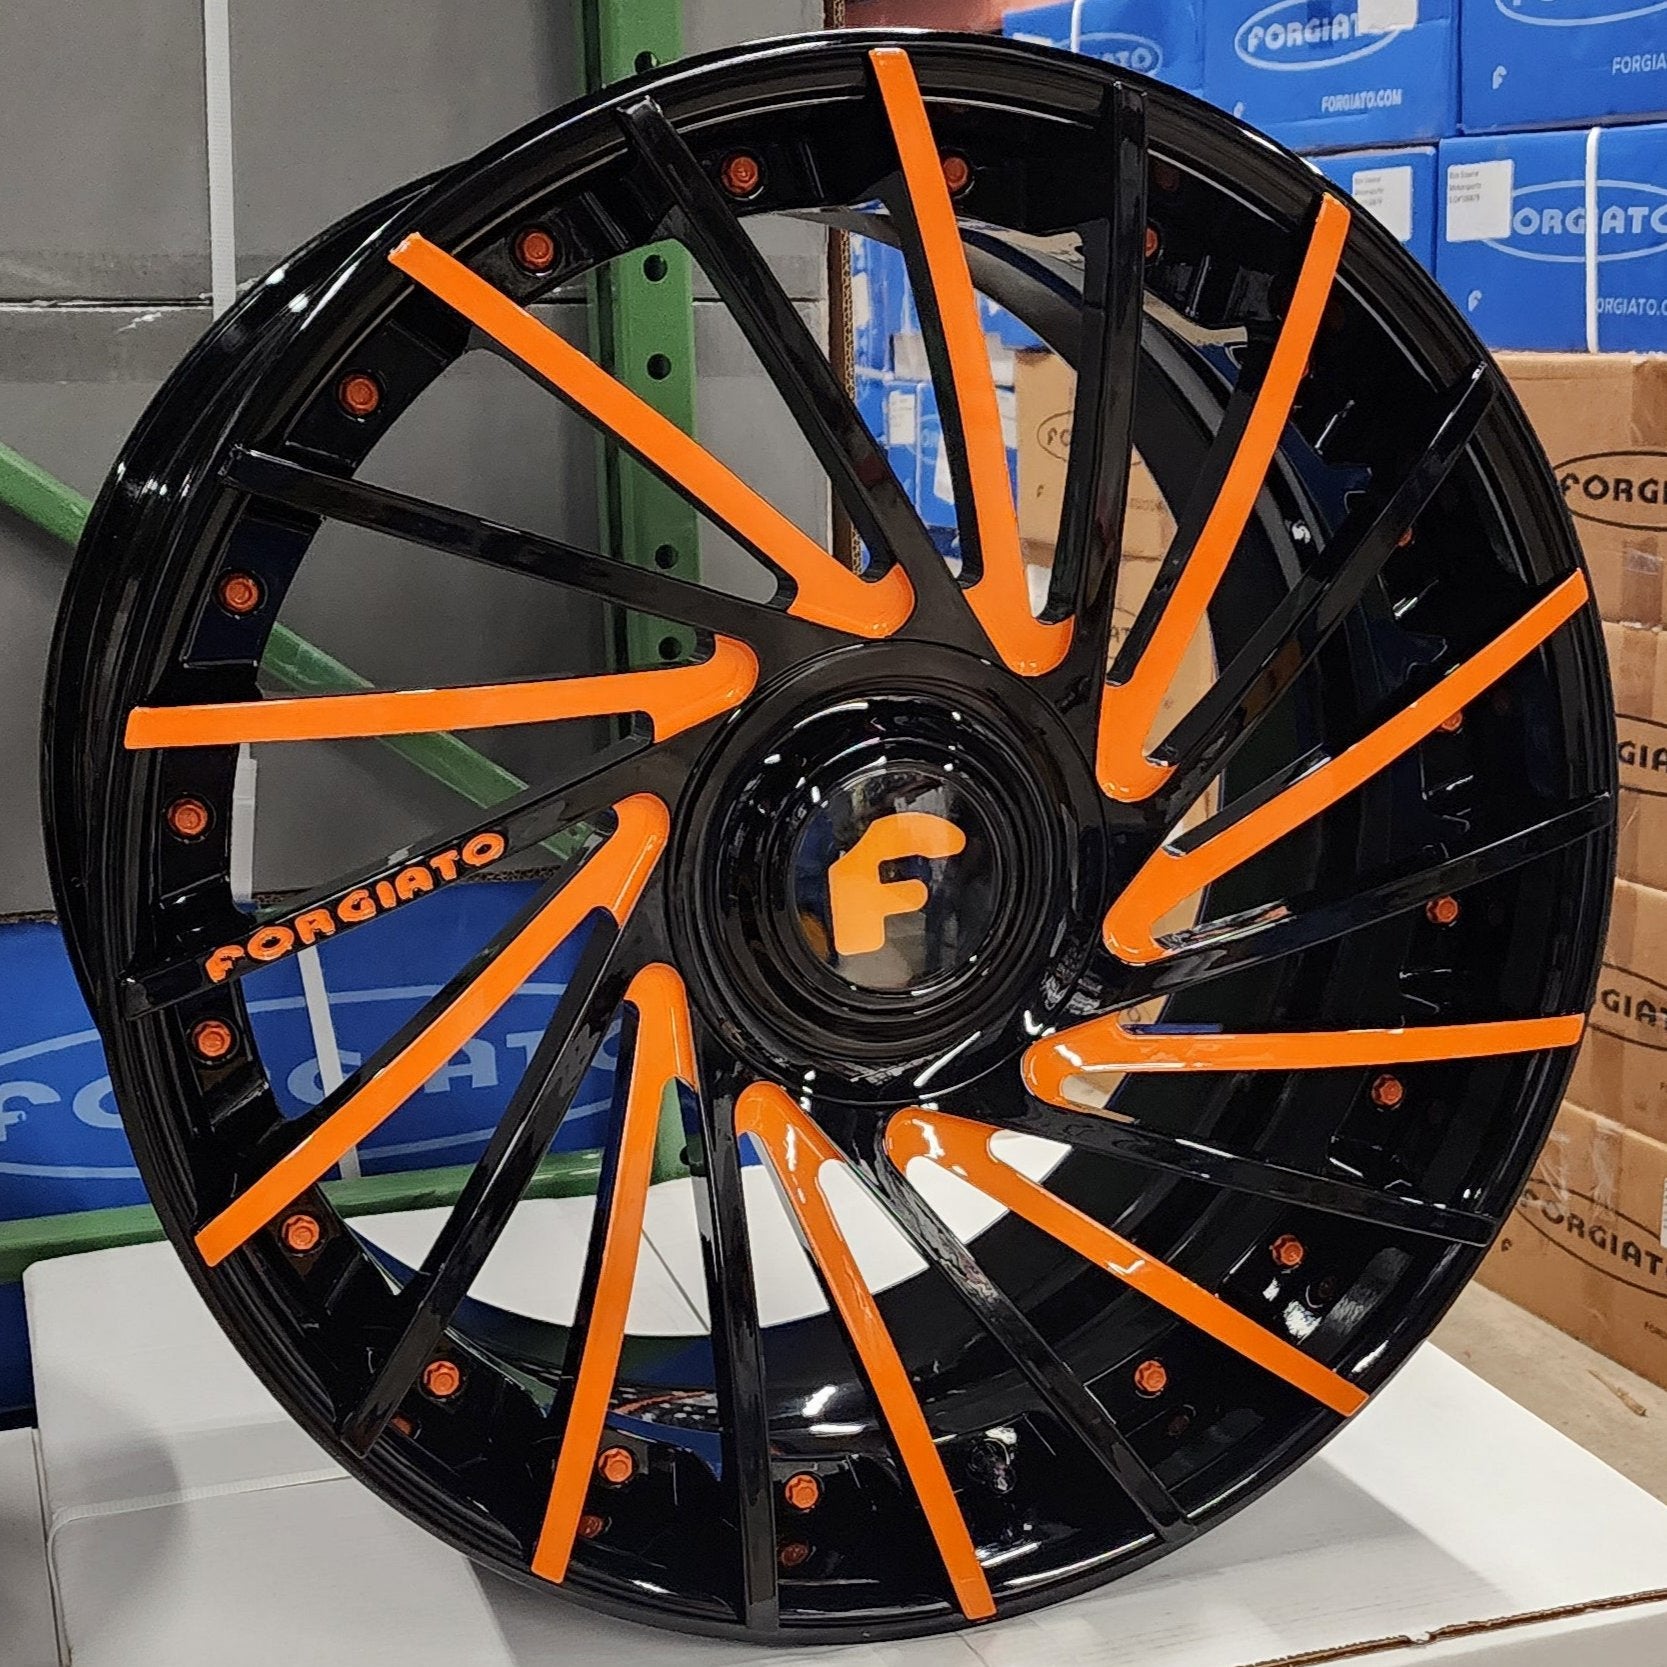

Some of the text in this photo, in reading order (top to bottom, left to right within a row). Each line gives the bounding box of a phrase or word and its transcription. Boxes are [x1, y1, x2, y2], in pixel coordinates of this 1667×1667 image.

[1612, 52, 1667, 76] FORGIA
[1321, 89, 1403, 113] FORGIATO.COM
[205, 833, 505, 983] FORGIATO
[1521, 1188, 1667, 1276] FORGIAT
